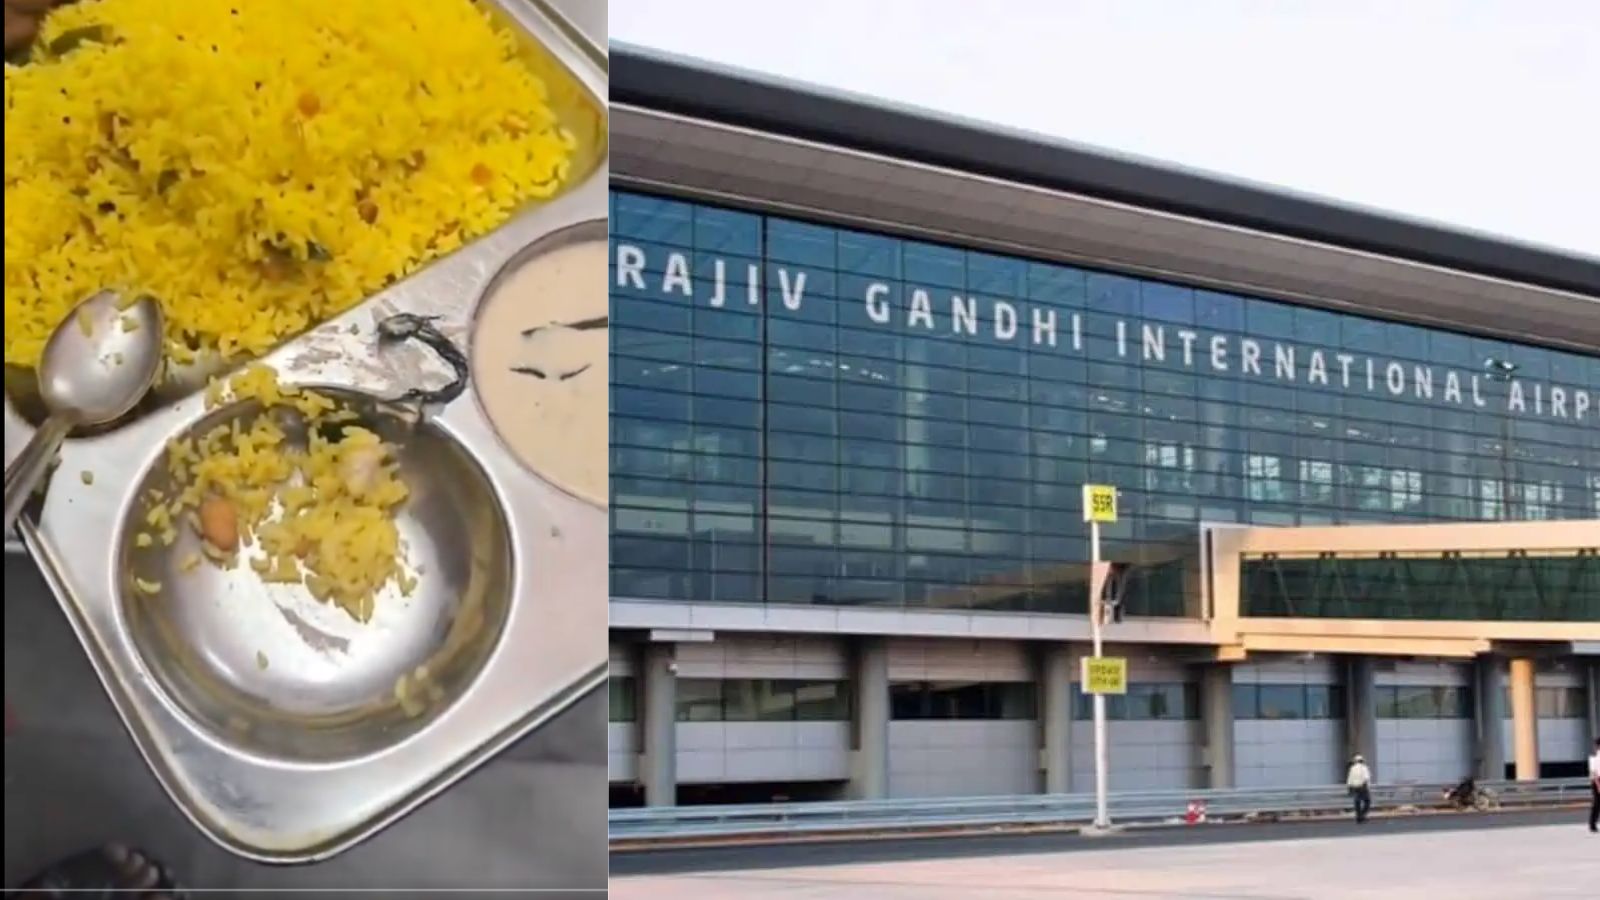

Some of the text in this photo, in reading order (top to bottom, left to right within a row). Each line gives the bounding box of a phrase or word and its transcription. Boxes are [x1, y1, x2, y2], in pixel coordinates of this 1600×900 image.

[616, 245, 1600, 420] RAJIV GANDHI INTERNATIONAL AIRP
